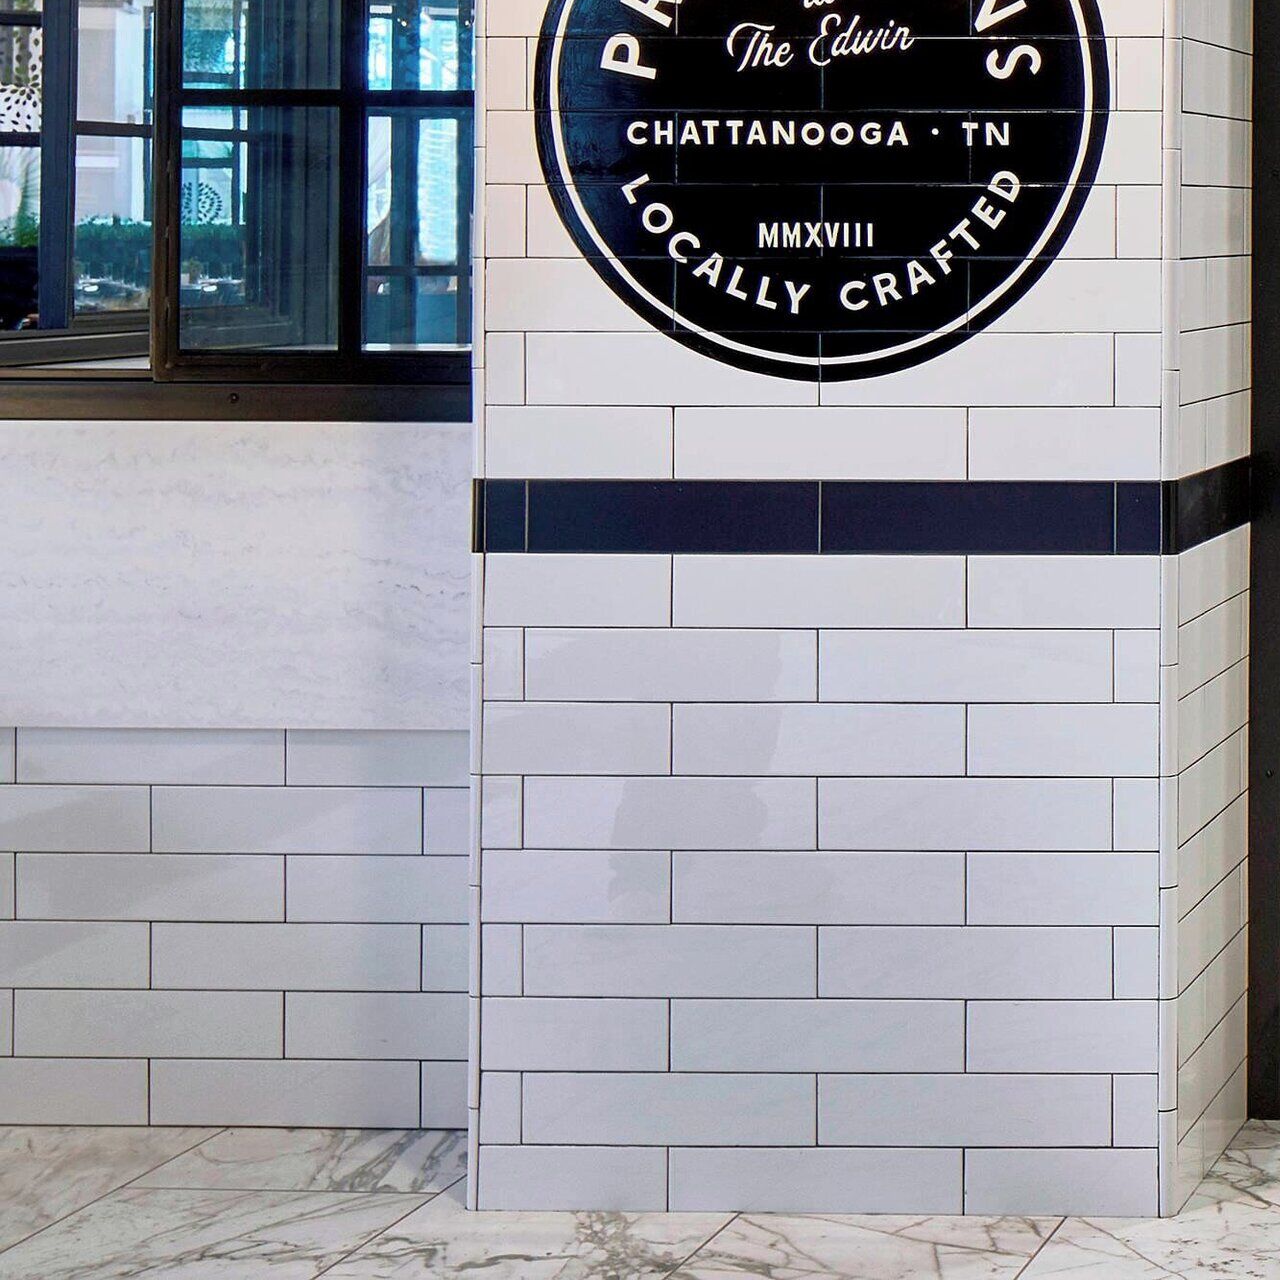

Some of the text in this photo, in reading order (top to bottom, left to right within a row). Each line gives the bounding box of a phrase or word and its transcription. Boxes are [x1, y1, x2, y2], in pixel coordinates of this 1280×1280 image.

[726, 13, 915, 73] The Edwin
[627, 120, 1010, 147] CHATTANOOGA TN
[621, 170, 1022, 315] LOCALLY CRAFTED
[758, 222, 874, 249] MMXVIII
